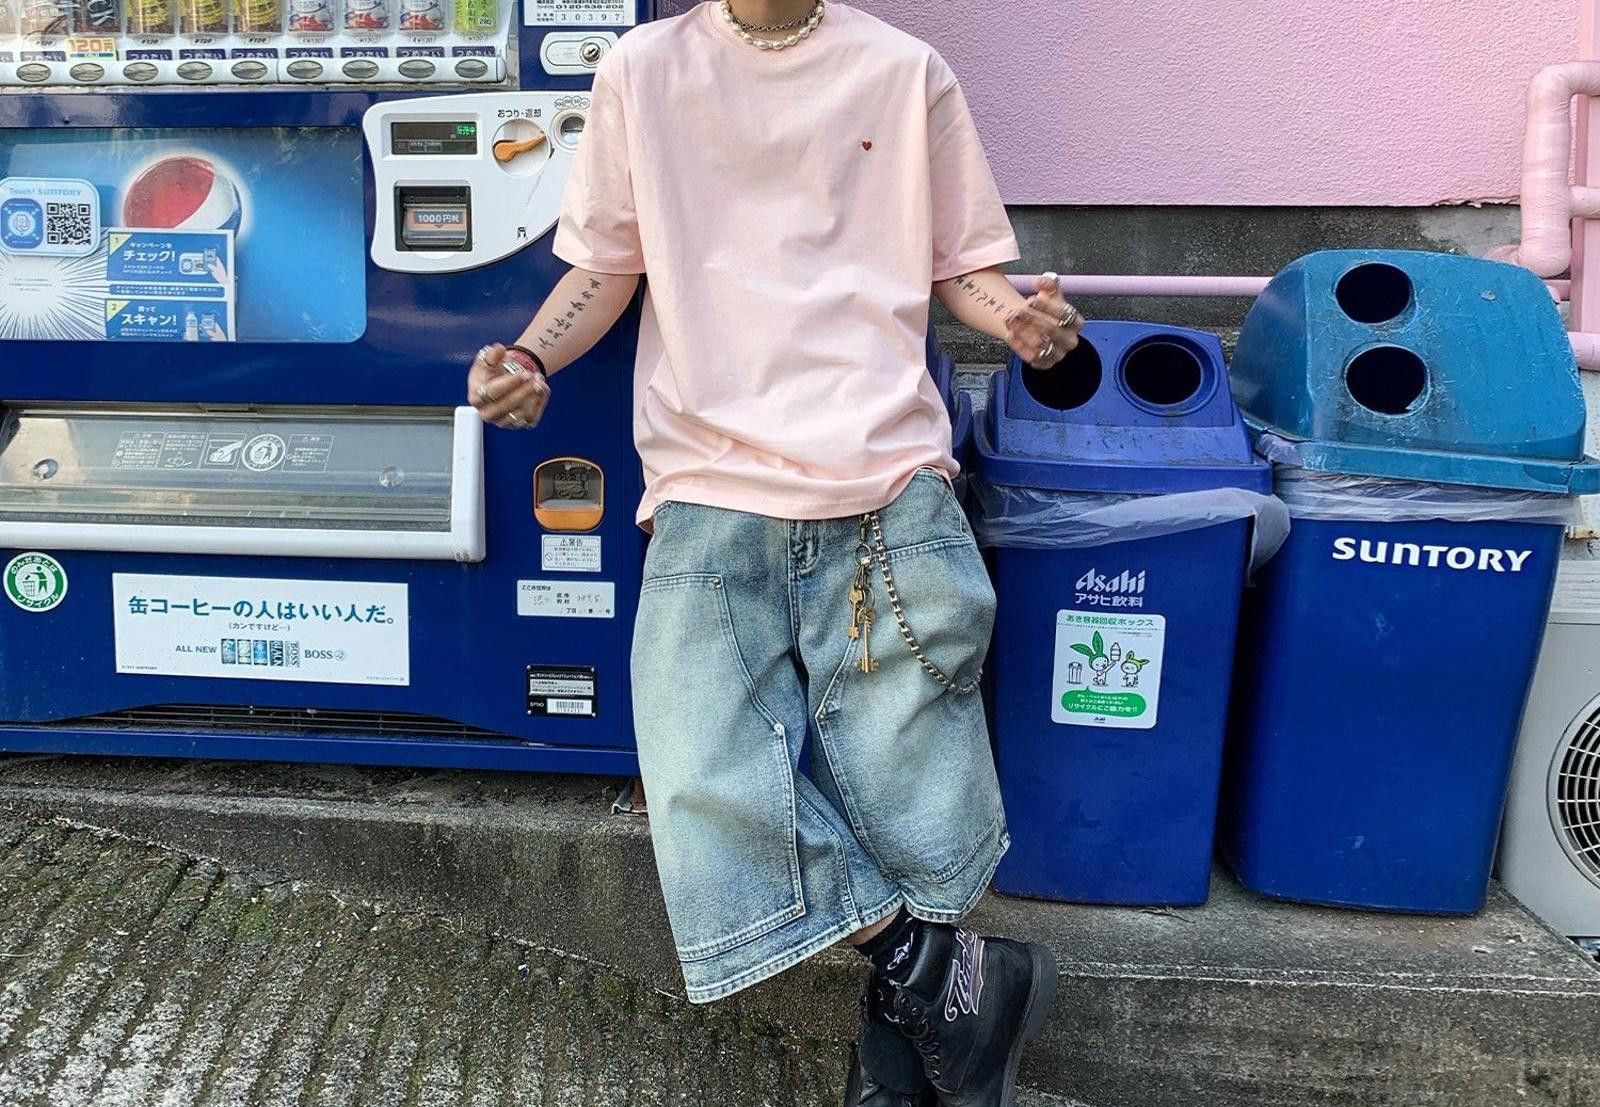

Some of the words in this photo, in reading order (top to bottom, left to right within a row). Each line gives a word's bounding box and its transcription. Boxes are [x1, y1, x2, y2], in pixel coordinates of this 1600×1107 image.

[123, 250, 176, 262] チェック!
[121, 314, 177, 326] スキャン!
[1332, 536, 1533, 572] SUNTORY
[1075, 568, 1146, 594] Asahi
[1074, 592, 1144, 608] アサヒ飲料
[127, 595, 395, 625] 缶コーヒーの人はいい人だ。
[1066, 614, 1155, 627] あき容器回収ボックス
[175, 645, 193, 653] ALL
[196, 645, 217, 654] NEW
[304, 649, 334, 660] BOSS
